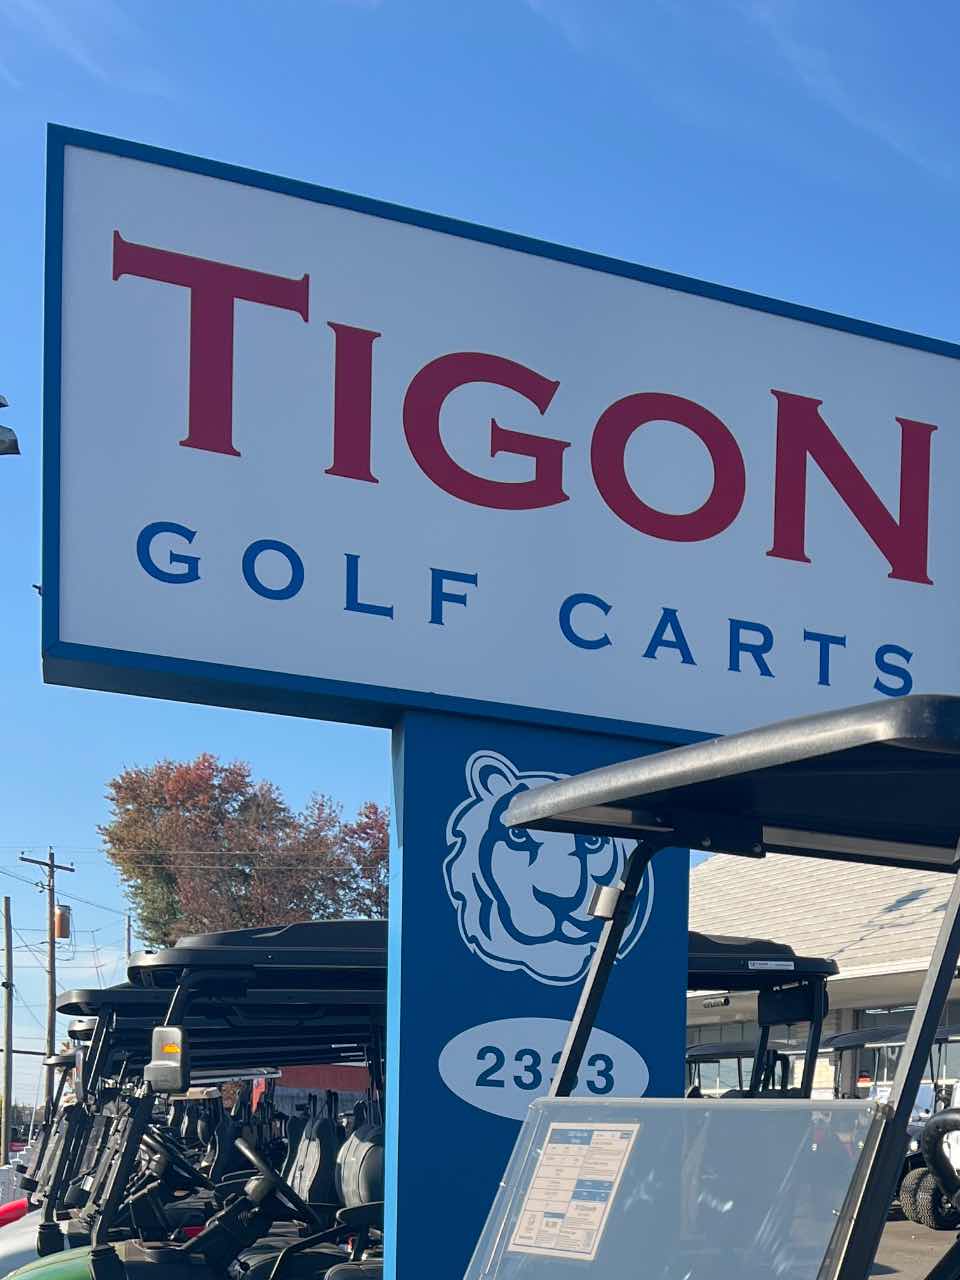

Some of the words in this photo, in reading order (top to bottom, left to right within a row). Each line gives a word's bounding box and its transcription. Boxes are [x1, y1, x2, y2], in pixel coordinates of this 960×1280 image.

[112, 230, 937, 587] TIGON
[136, 521, 479, 626] GOLF
[558, 592, 914, 697] CARTS
